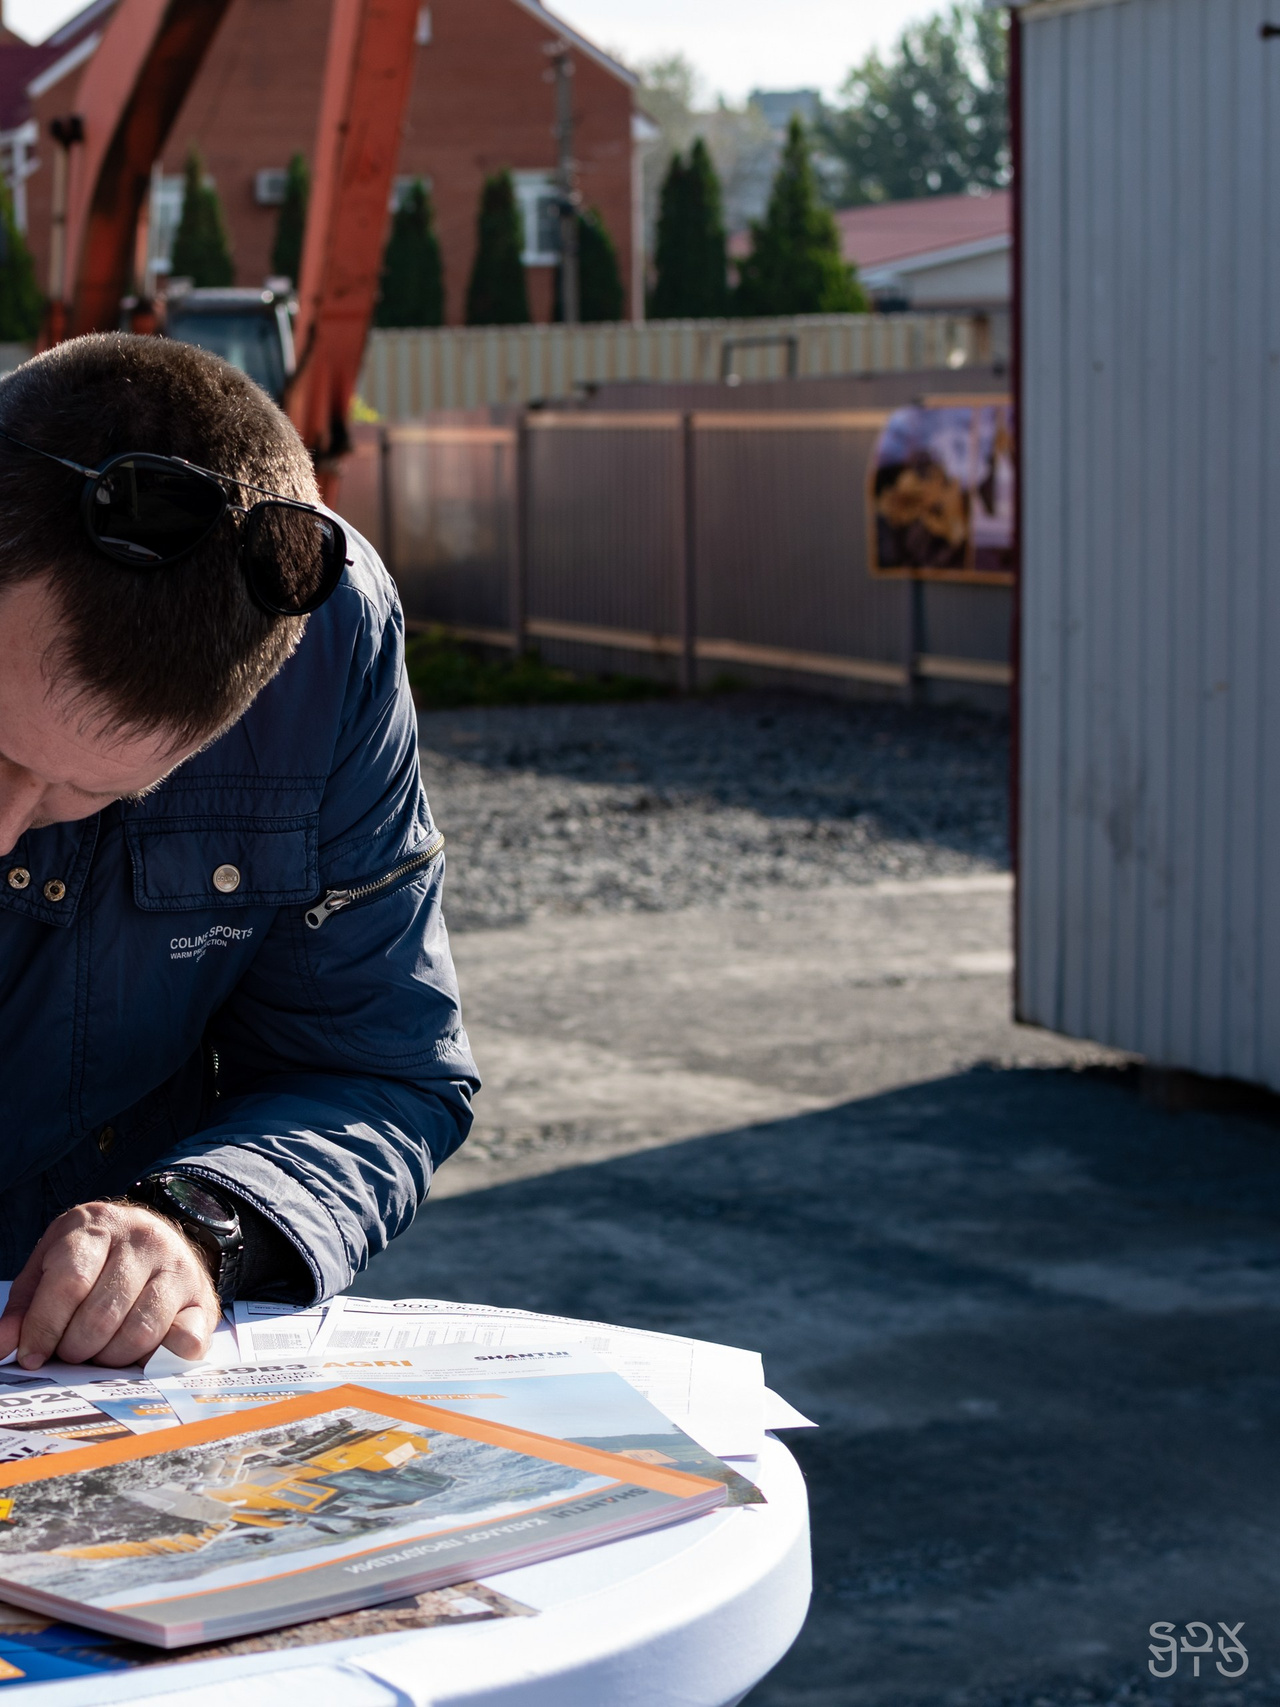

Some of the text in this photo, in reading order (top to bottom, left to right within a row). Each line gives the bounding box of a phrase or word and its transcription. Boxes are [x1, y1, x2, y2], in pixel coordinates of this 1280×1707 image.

[208, 925, 253, 940] SPORTS
[170, 951, 193, 960] WARM
[474, 1351, 569, 1361] SHANTUI
[549, 1487, 650, 1519] SHANTUI
[342, 1516, 550, 1575] КАТАЛОГ ПРОДУКЦИИ
